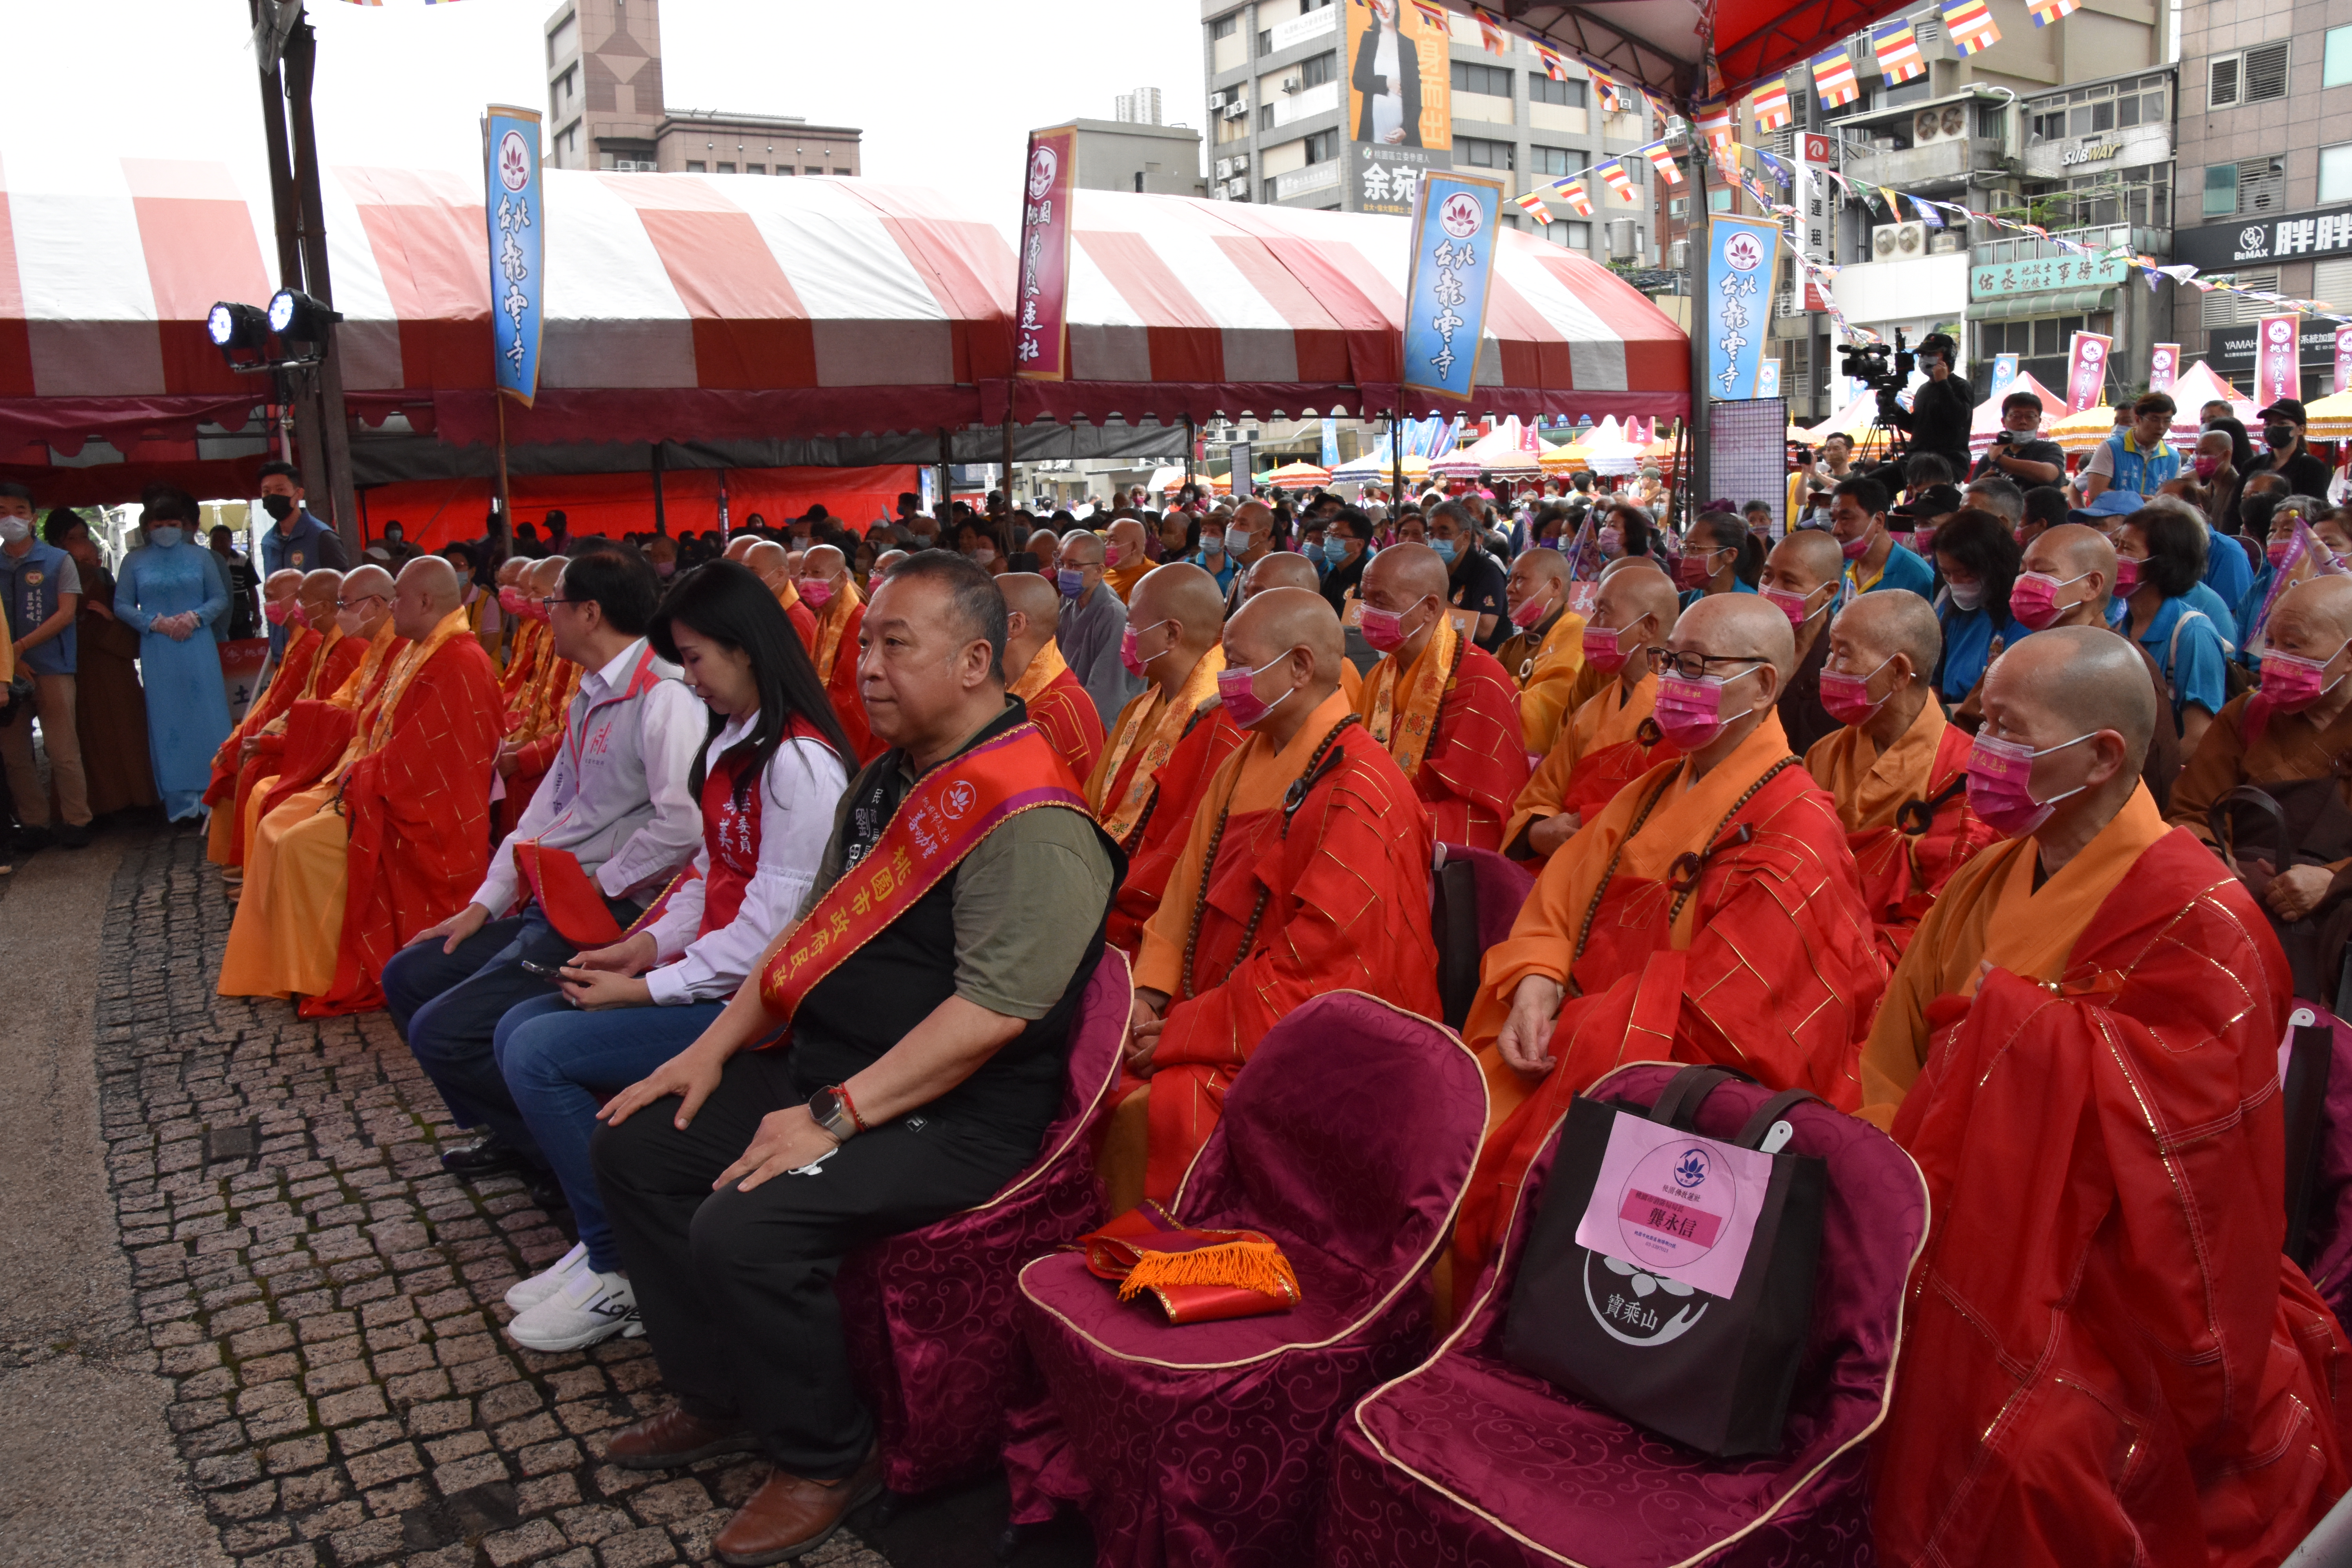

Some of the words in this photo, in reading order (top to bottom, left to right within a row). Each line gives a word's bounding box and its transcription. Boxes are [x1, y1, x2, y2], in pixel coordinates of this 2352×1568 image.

[2062, 142, 2122, 166] SUBWAY
[1362, 162, 1427, 202] 余宛
[1662, 1184, 1701, 1202] 桃園佛教蓮社
[1647, 1207, 1697, 1238] 龔永信
[1602, 1294, 1658, 1330] 寶乘山
